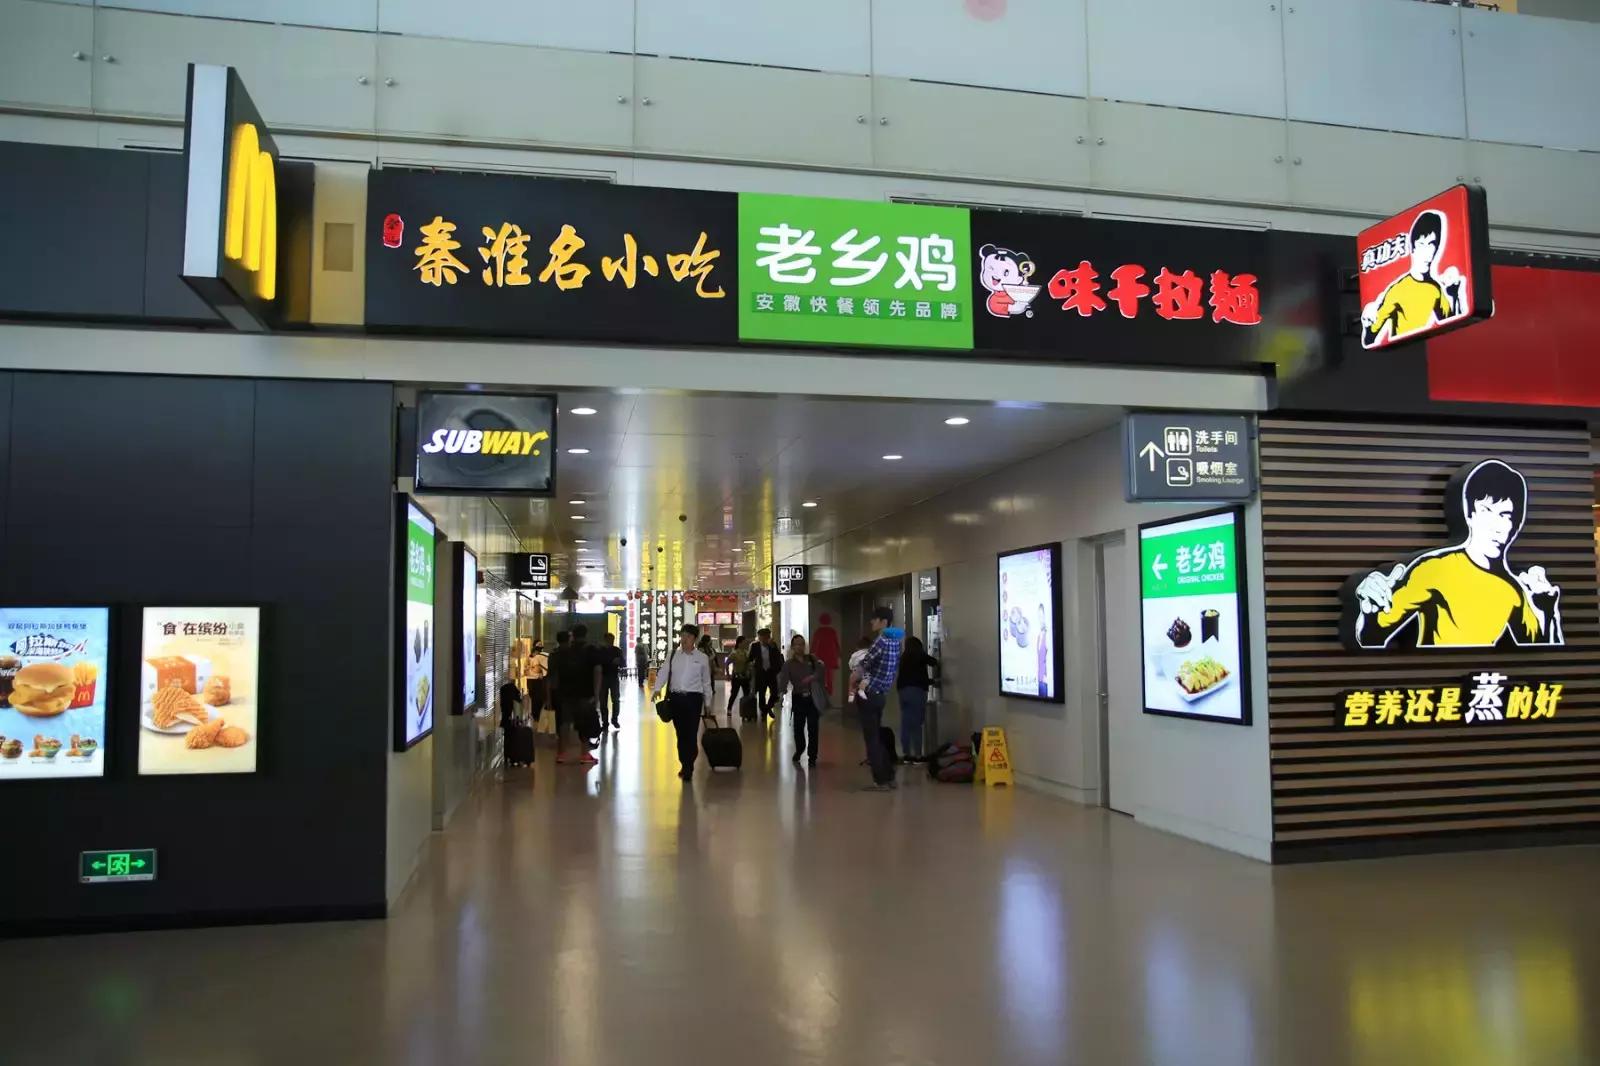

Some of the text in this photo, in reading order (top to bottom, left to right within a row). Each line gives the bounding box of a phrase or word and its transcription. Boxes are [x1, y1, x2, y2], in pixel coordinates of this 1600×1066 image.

[413, 216, 726, 298] 秦淮名小吃
[755, 223, 957, 291] 老乡鸡
[1361, 234, 1407, 272] 真功夫
[756, 293, 959, 320] 安徽快餐领先品牌
[1195, 430, 1238, 445] 洗手间
[1196, 461, 1238, 475] 吸烟室
[1176, 540, 1225, 575] 老乡鸡
[1344, 673, 1563, 726] 营养还是蒸的好
